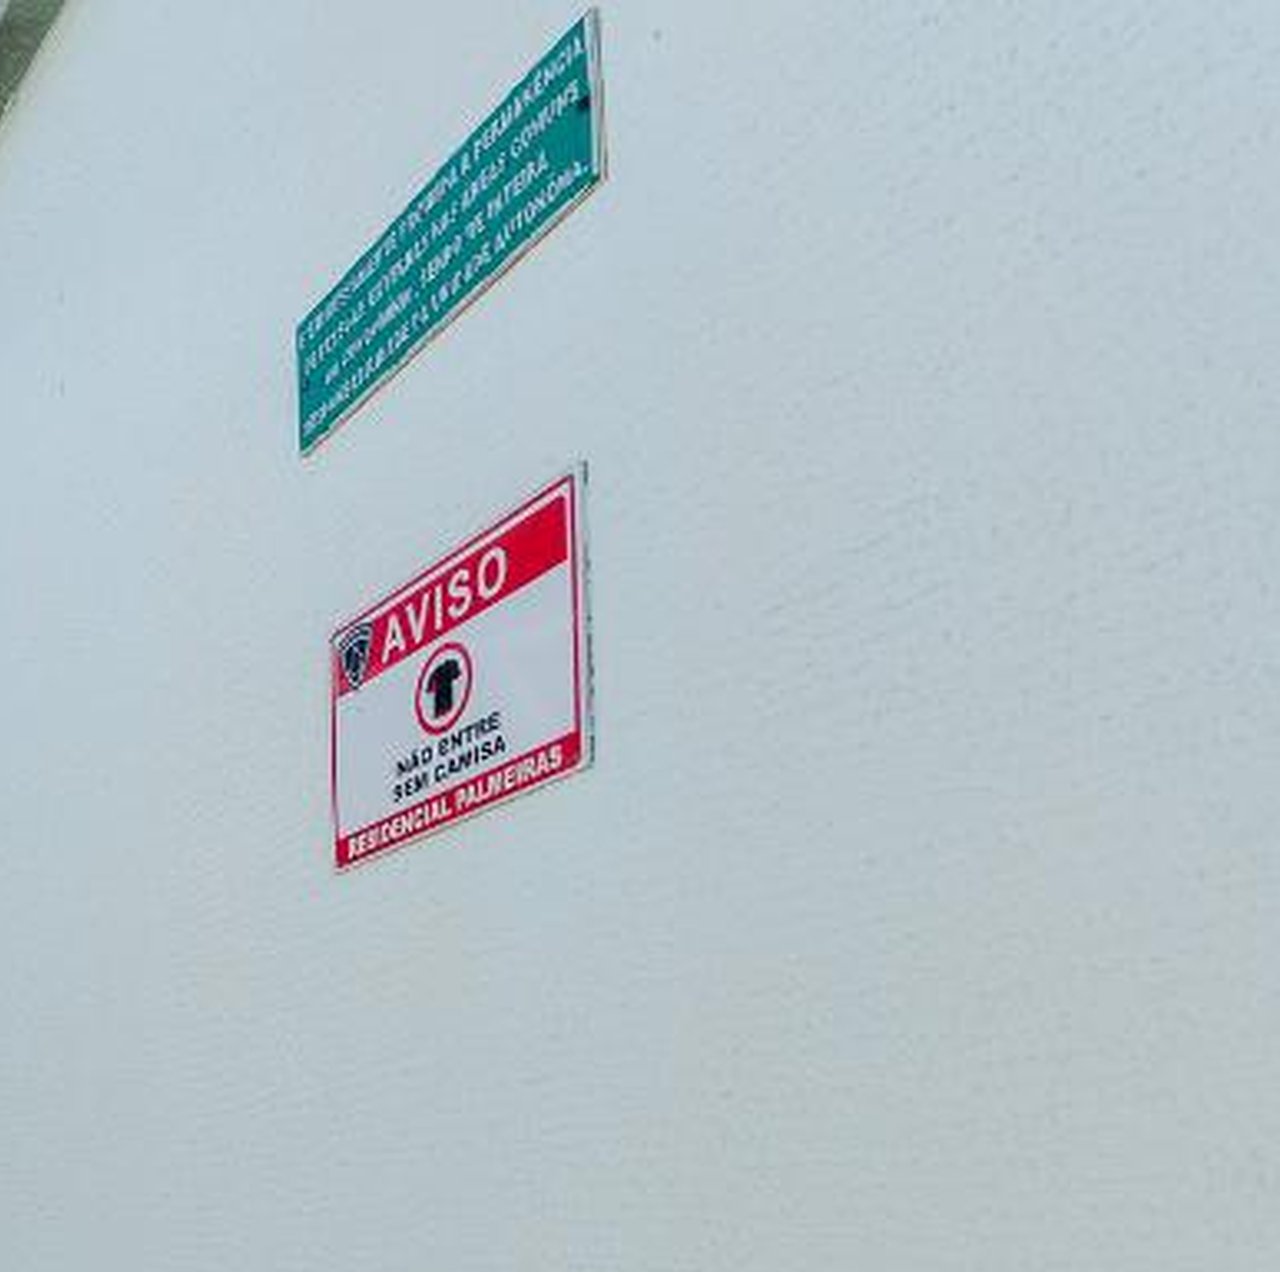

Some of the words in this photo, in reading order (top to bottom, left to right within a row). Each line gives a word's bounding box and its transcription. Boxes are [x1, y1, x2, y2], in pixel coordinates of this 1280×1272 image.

[381, 545, 507, 664] AVISO
[393, 771, 428, 803] SEM
[434, 735, 506, 782] CAMISA
[397, 740, 433, 777] NÃO
[438, 711, 501, 758] ENTRE
[348, 795, 451, 858] RESIDENCIAL
[455, 744, 562, 814] PALMEIRAS
